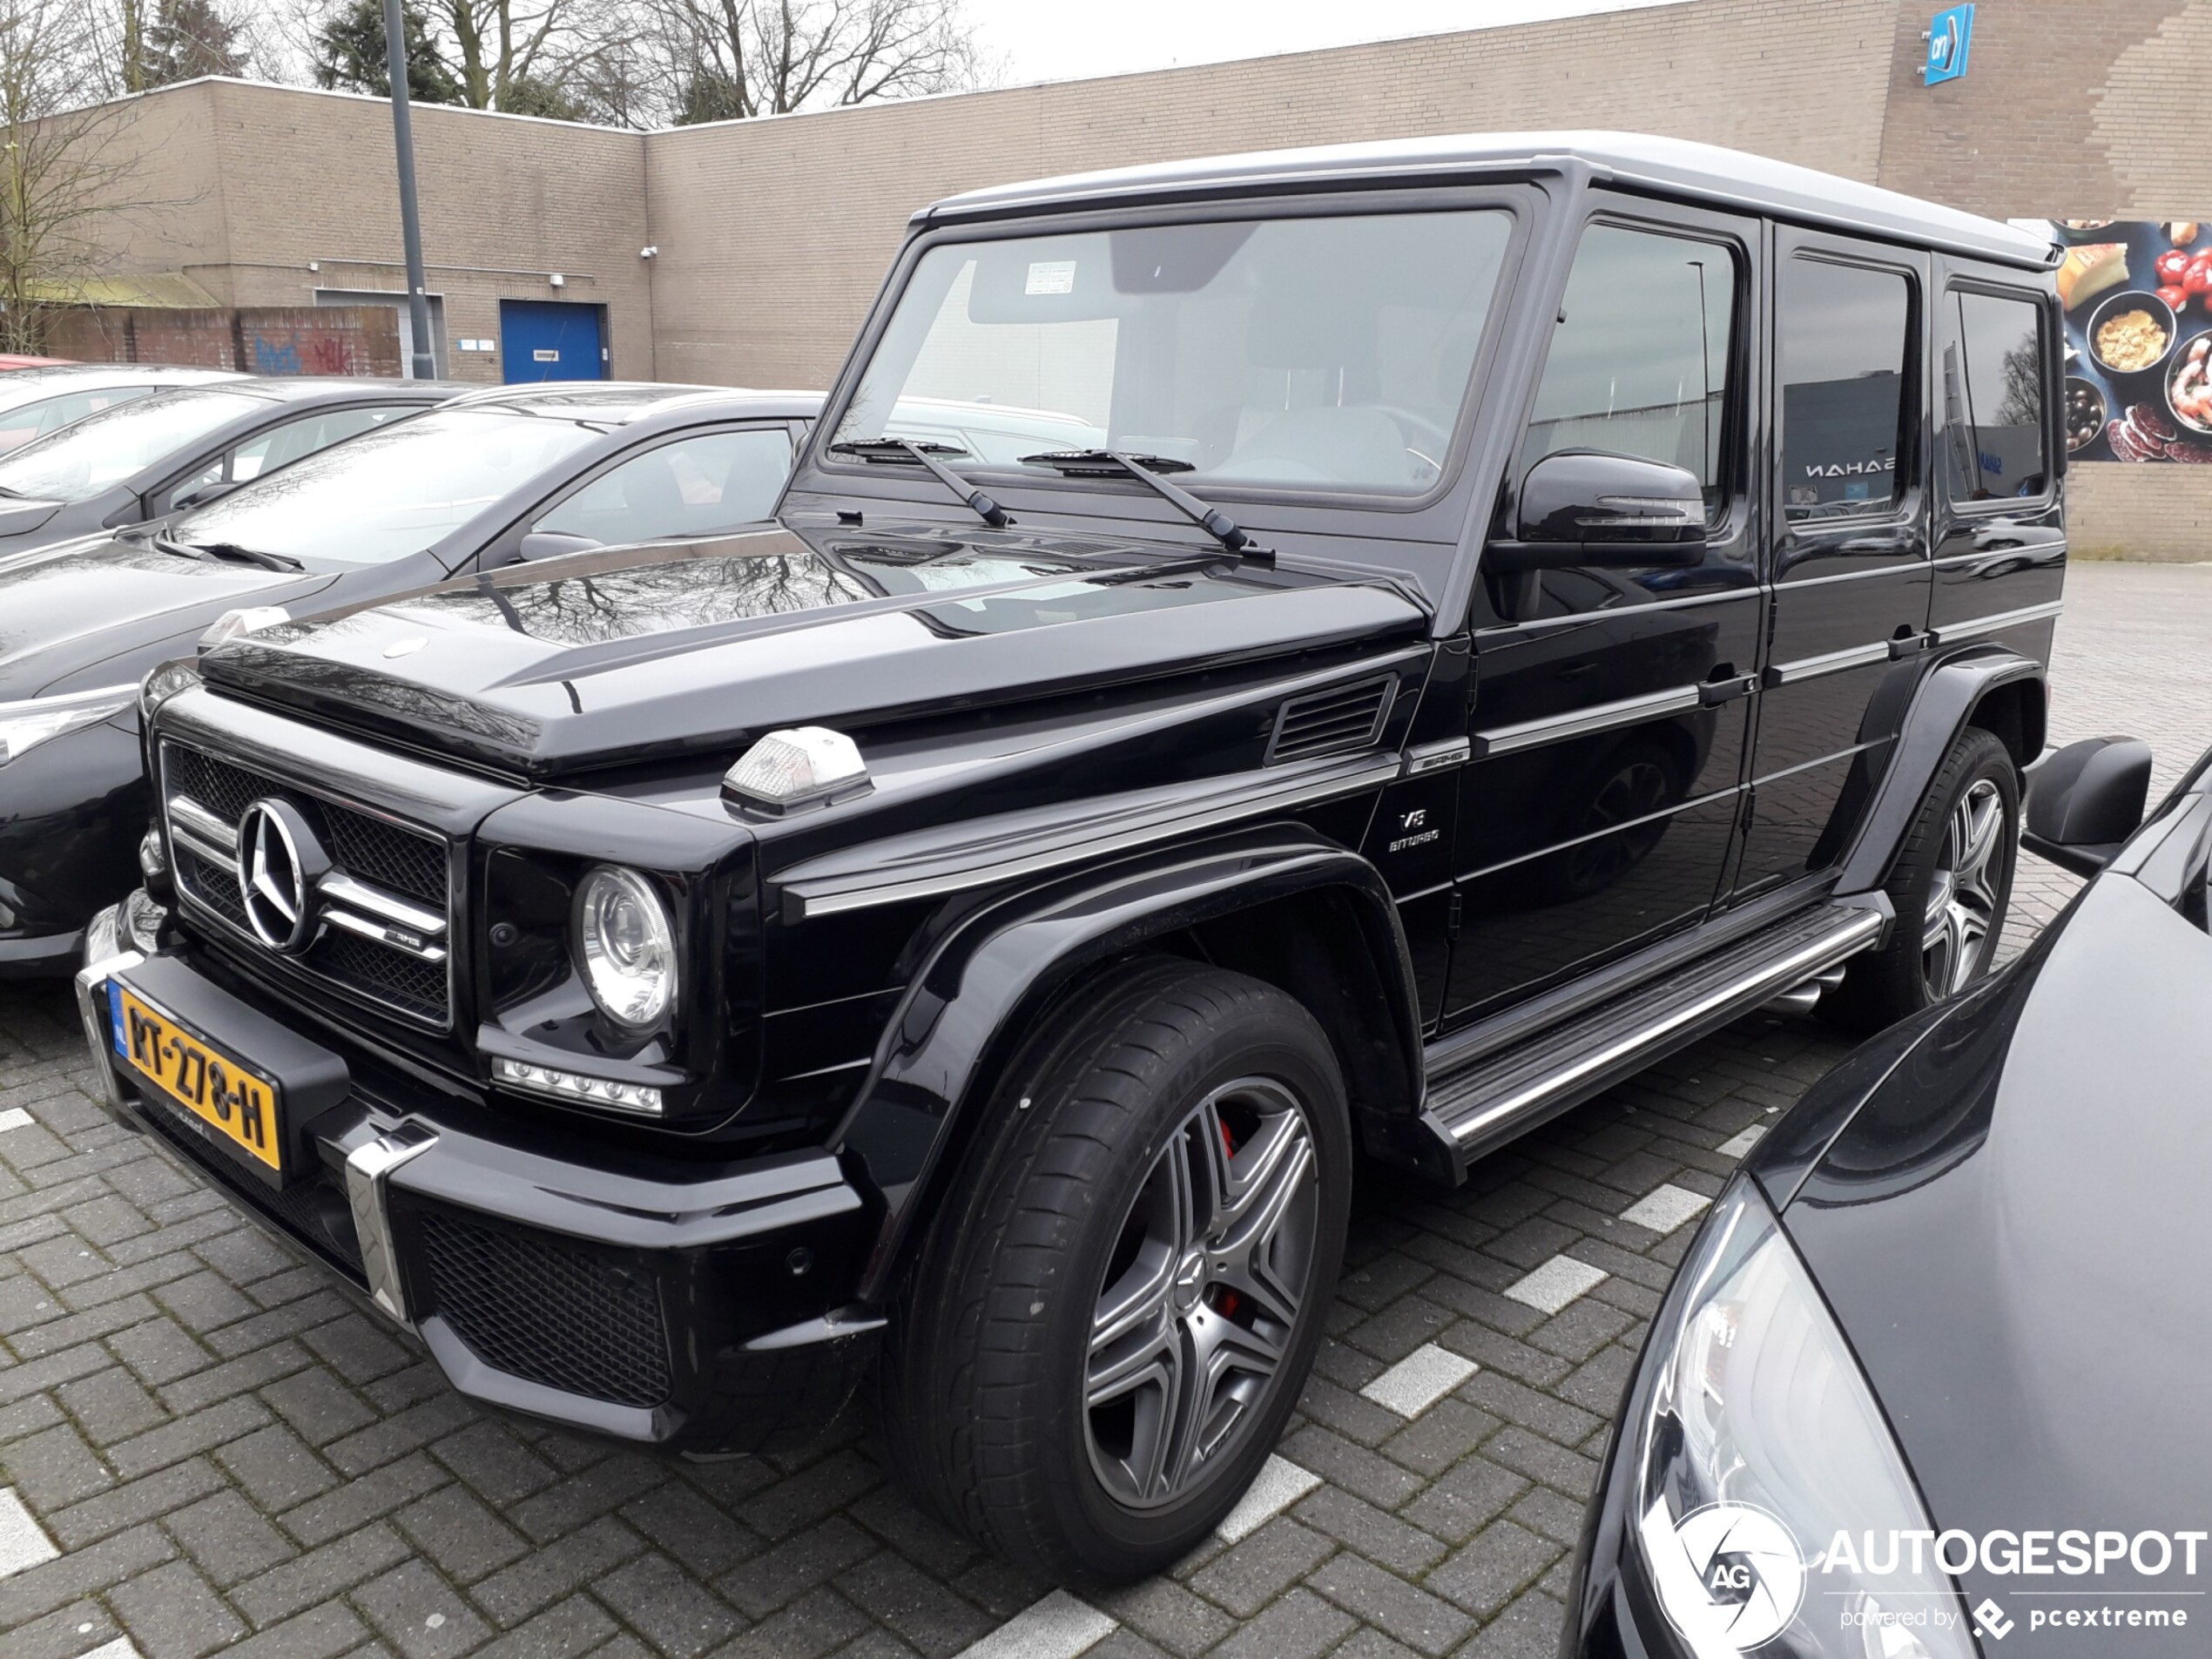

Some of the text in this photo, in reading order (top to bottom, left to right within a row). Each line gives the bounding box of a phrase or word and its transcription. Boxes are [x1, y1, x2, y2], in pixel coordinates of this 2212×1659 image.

[1434, 752, 1464, 765] AMG
[1399, 809, 1427, 831] V8
[1389, 829, 1440, 853] BITURBO
[115, 1023, 127, 1046] NL
[129, 1005, 266, 1150] RT-278-H
